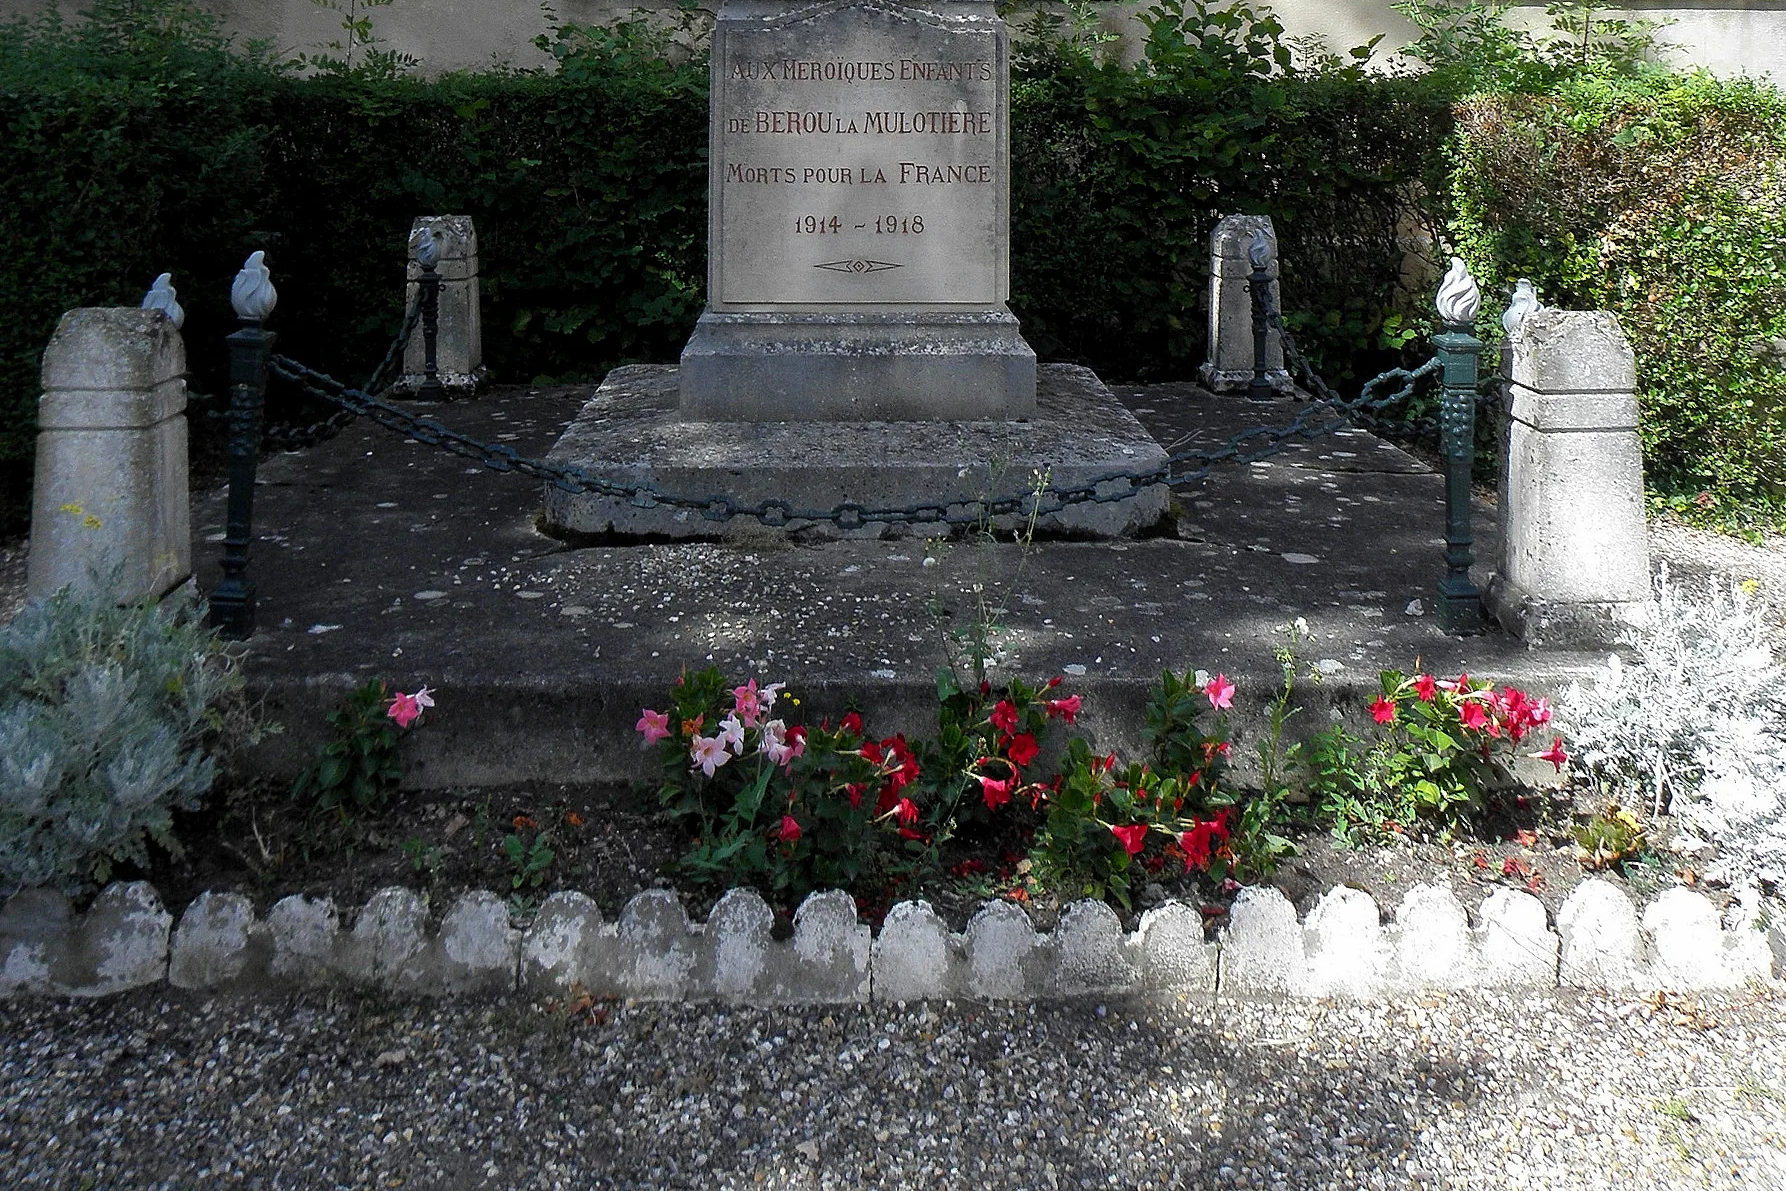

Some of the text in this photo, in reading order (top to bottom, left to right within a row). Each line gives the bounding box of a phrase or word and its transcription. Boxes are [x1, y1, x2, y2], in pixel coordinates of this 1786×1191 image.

[729, 62, 776, 81] AUX
[899, 60, 991, 81] ENFANTS
[729, 111, 991, 135] DE BEROU LA MULOTIERE
[726, 162, 991, 184] MORTS POUR LA FRANCE
[795, 215, 842, 234] 1914
[875, 215, 925, 234] 1918
